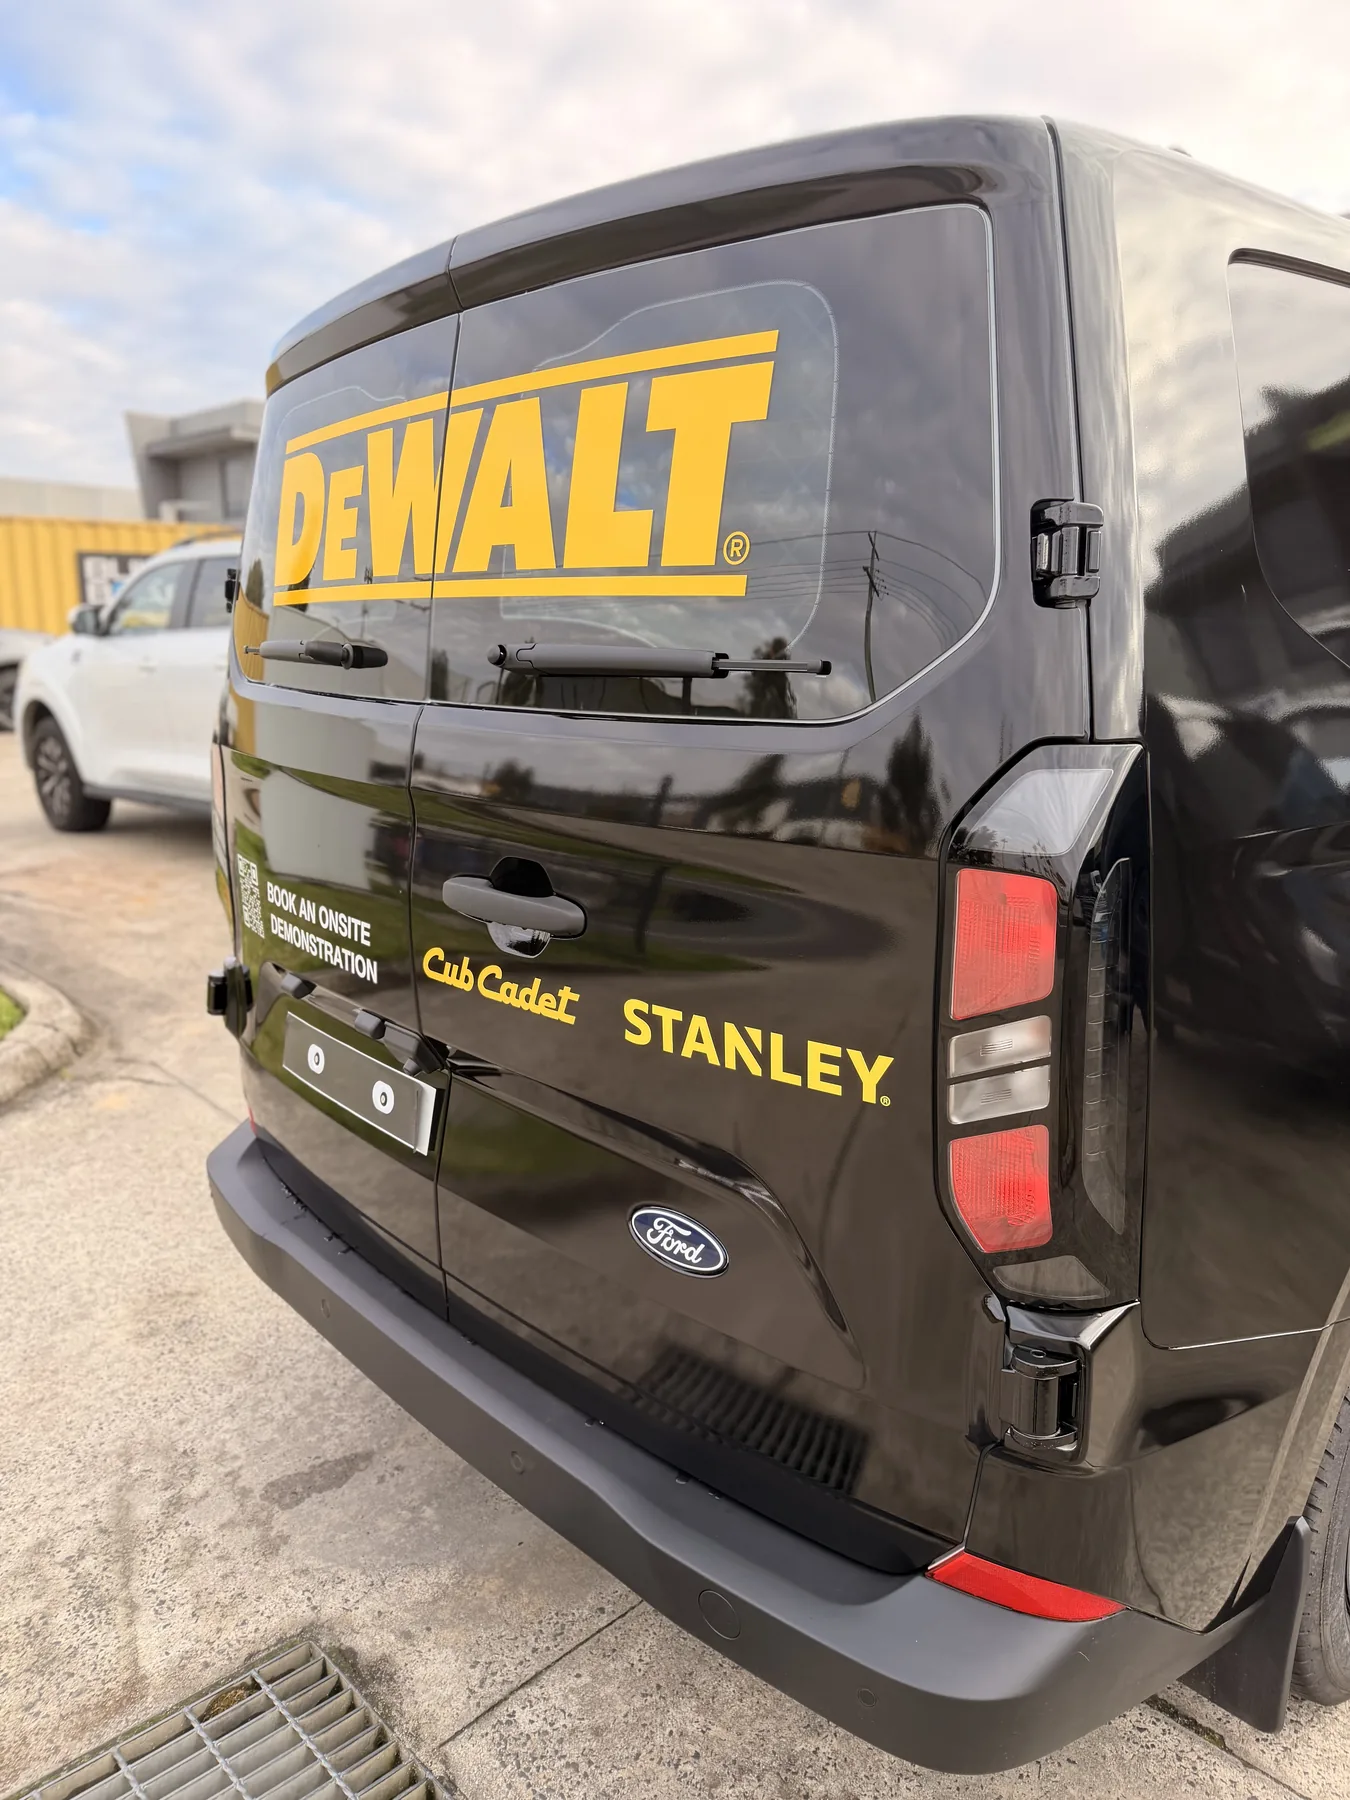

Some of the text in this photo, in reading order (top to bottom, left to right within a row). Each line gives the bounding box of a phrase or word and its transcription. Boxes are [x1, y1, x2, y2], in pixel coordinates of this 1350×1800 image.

[266, 881, 371, 947] BOOK AN ONSITE
[270, 913, 378, 984] DEMONSTRATION
[422, 947, 580, 1025] Cub Cadet
[623, 998, 894, 1105] STANLEY
[646, 1217, 706, 1264] Ford
